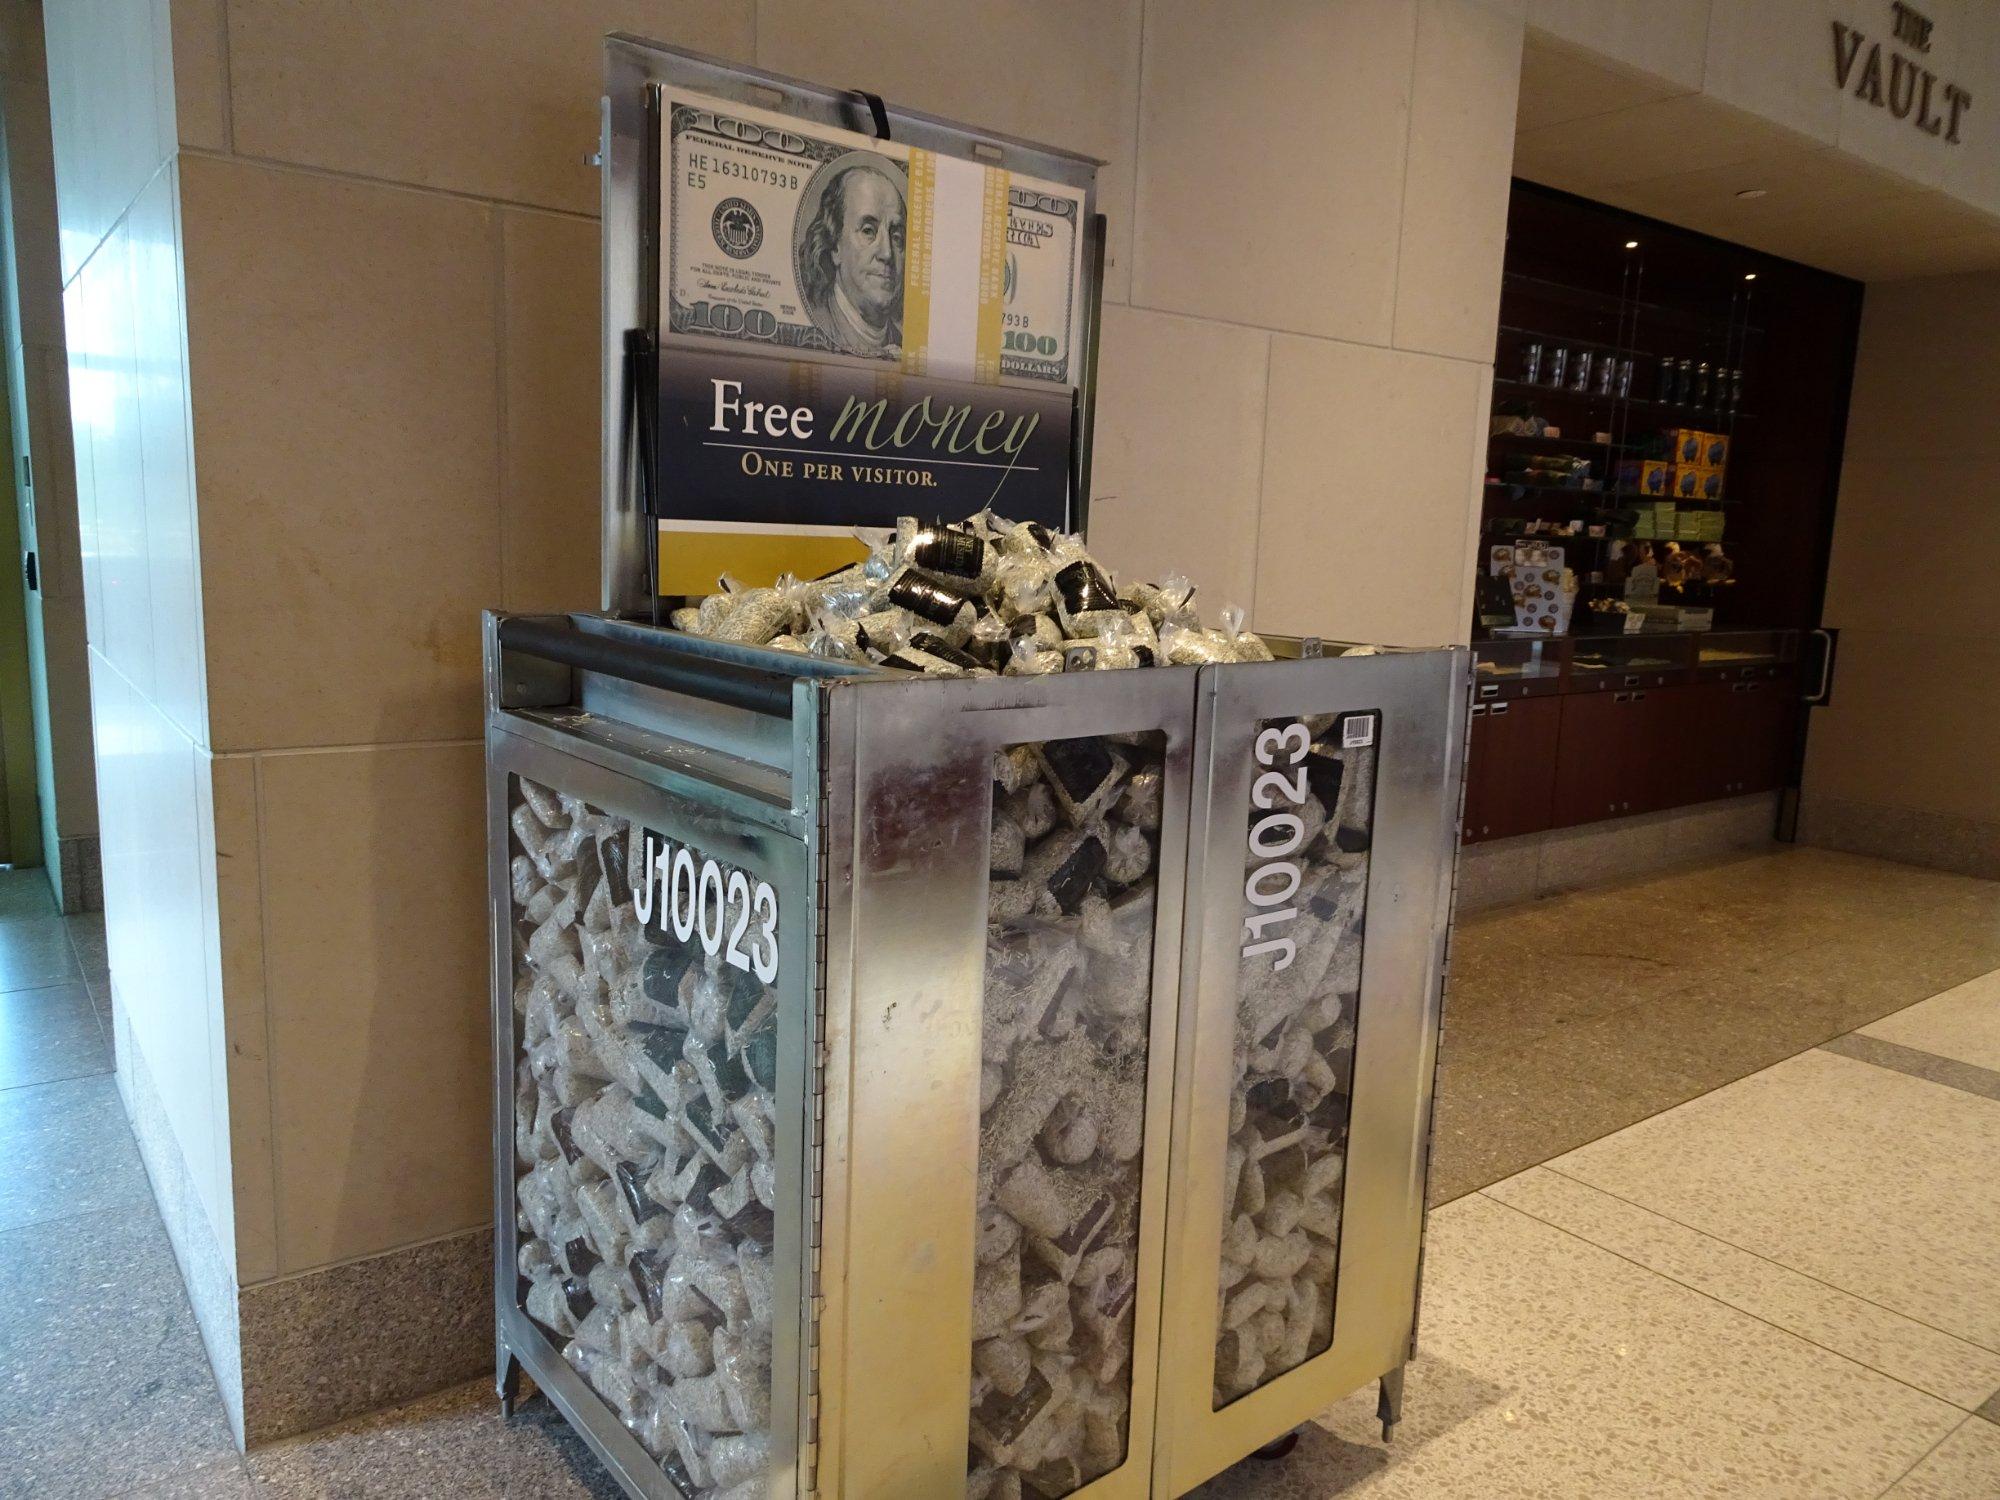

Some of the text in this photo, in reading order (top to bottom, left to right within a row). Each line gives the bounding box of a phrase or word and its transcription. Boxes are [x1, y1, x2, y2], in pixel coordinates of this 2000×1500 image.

[1832, 21, 1973, 145] VAULT
[685, 134, 735, 152] FEDERAL
[687, 172, 706, 190] E5
[688, 301, 777, 337] 100
[1001, 330, 1057, 356] 100
[1001, 359, 1060, 375] DOLLARS
[709, 378, 1040, 500] Free money
[741, 451, 938, 487] ONE PER VISITOR.
[1243, 722, 1311, 971] J10023
[633, 836, 778, 984] J10023
